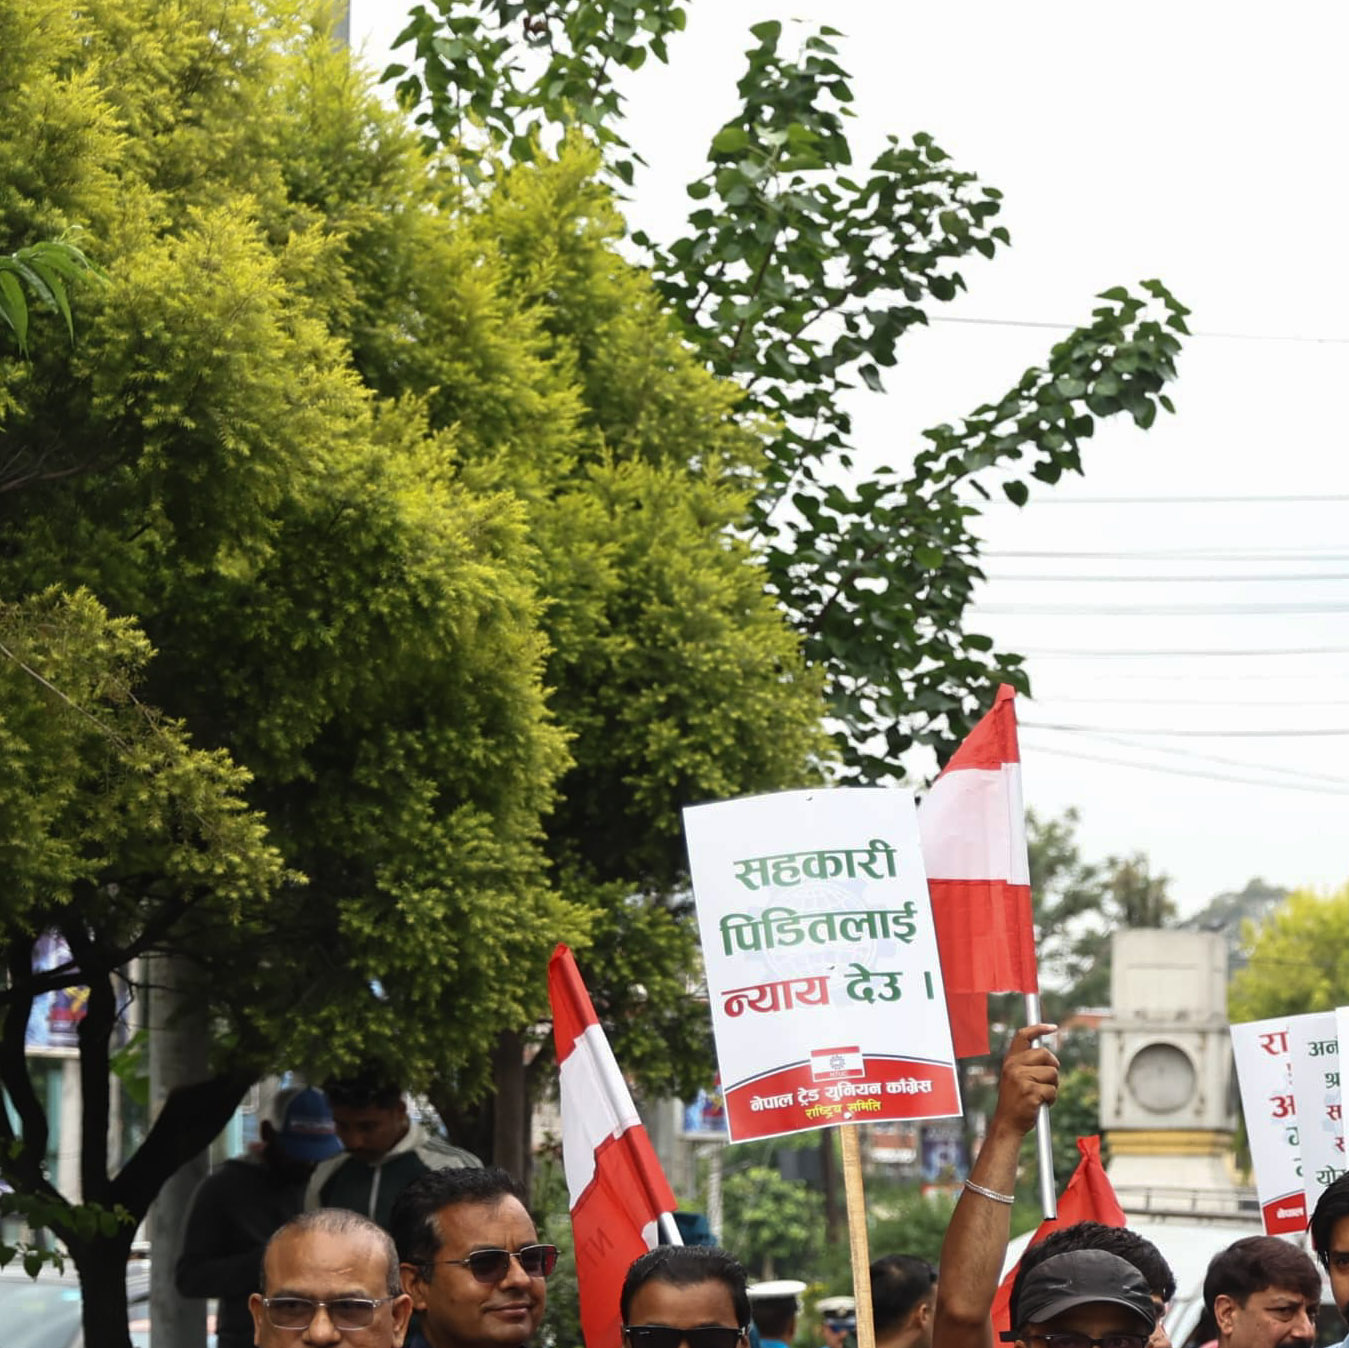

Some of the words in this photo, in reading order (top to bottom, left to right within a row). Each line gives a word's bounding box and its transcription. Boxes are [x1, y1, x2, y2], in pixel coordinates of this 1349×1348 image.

[733, 838, 897, 890] सहकारी
[720, 901, 918, 956] पिडितलाई
[721, 975, 830, 1018] न्याय
[843, 963, 903, 1005] देउ
[750, 1093, 793, 1112] नेपाल
[797, 1087, 820, 1107] ट्रेड
[824, 1081, 882, 1102] युनियन
[847, 1098, 882, 1114] समिति
